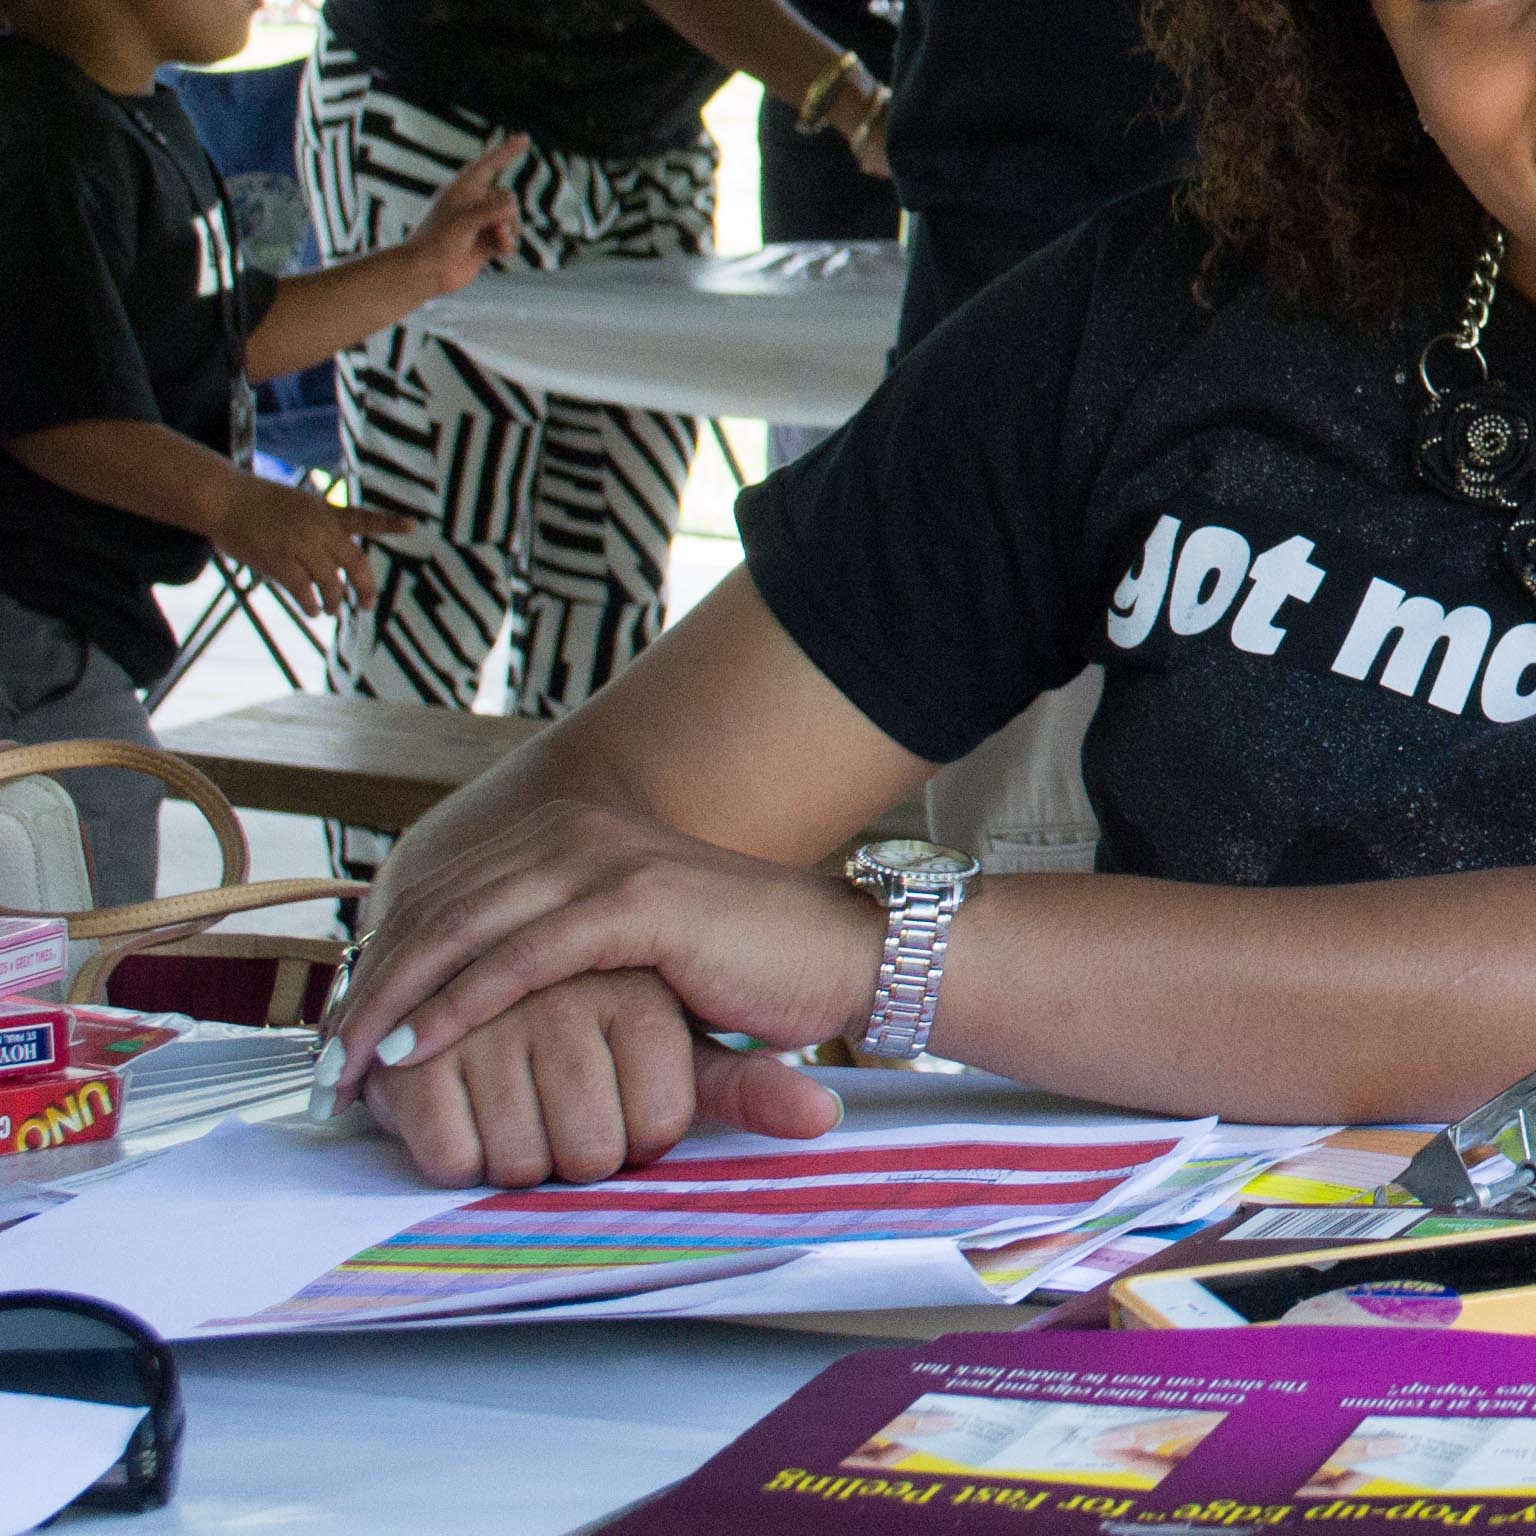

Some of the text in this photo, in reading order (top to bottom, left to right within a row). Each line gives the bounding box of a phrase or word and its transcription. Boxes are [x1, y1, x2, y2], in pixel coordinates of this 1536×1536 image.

[1107, 514, 1327, 655] got
[16, 1082, 113, 1153] UNO
[953, 1365, 1006, 1378] back
[1006, 1369, 1078, 1383] folded
[1080, 1372, 1108, 1384] be
[993, 1382, 1040, 1393] and
[1111, 1374, 1161, 1388] then
[1166, 1377, 1206, 1387] can
[1208, 1379, 1264, 1392] sheet
[1267, 1381, 1307, 1393] The
[1041, 1384, 1092, 1397] edge
[1093, 1388, 1149, 1401] label
[1152, 1391, 1189, 1402] the
[1192, 1393, 1246, 1405] Grab
[1340, 1398, 1425, 1412] column
[1430, 1399, 1444, 1409] a
[1447, 1399, 1471, 1411] at
[1476, 1399, 1527, 1413] back
[763, 1468, 943, 1504] Peeling
[951, 1485, 1050, 1512] Fast
[1057, 1495, 1134, 1519] for
[1303, 1500, 1482, 1527] Pop-up
